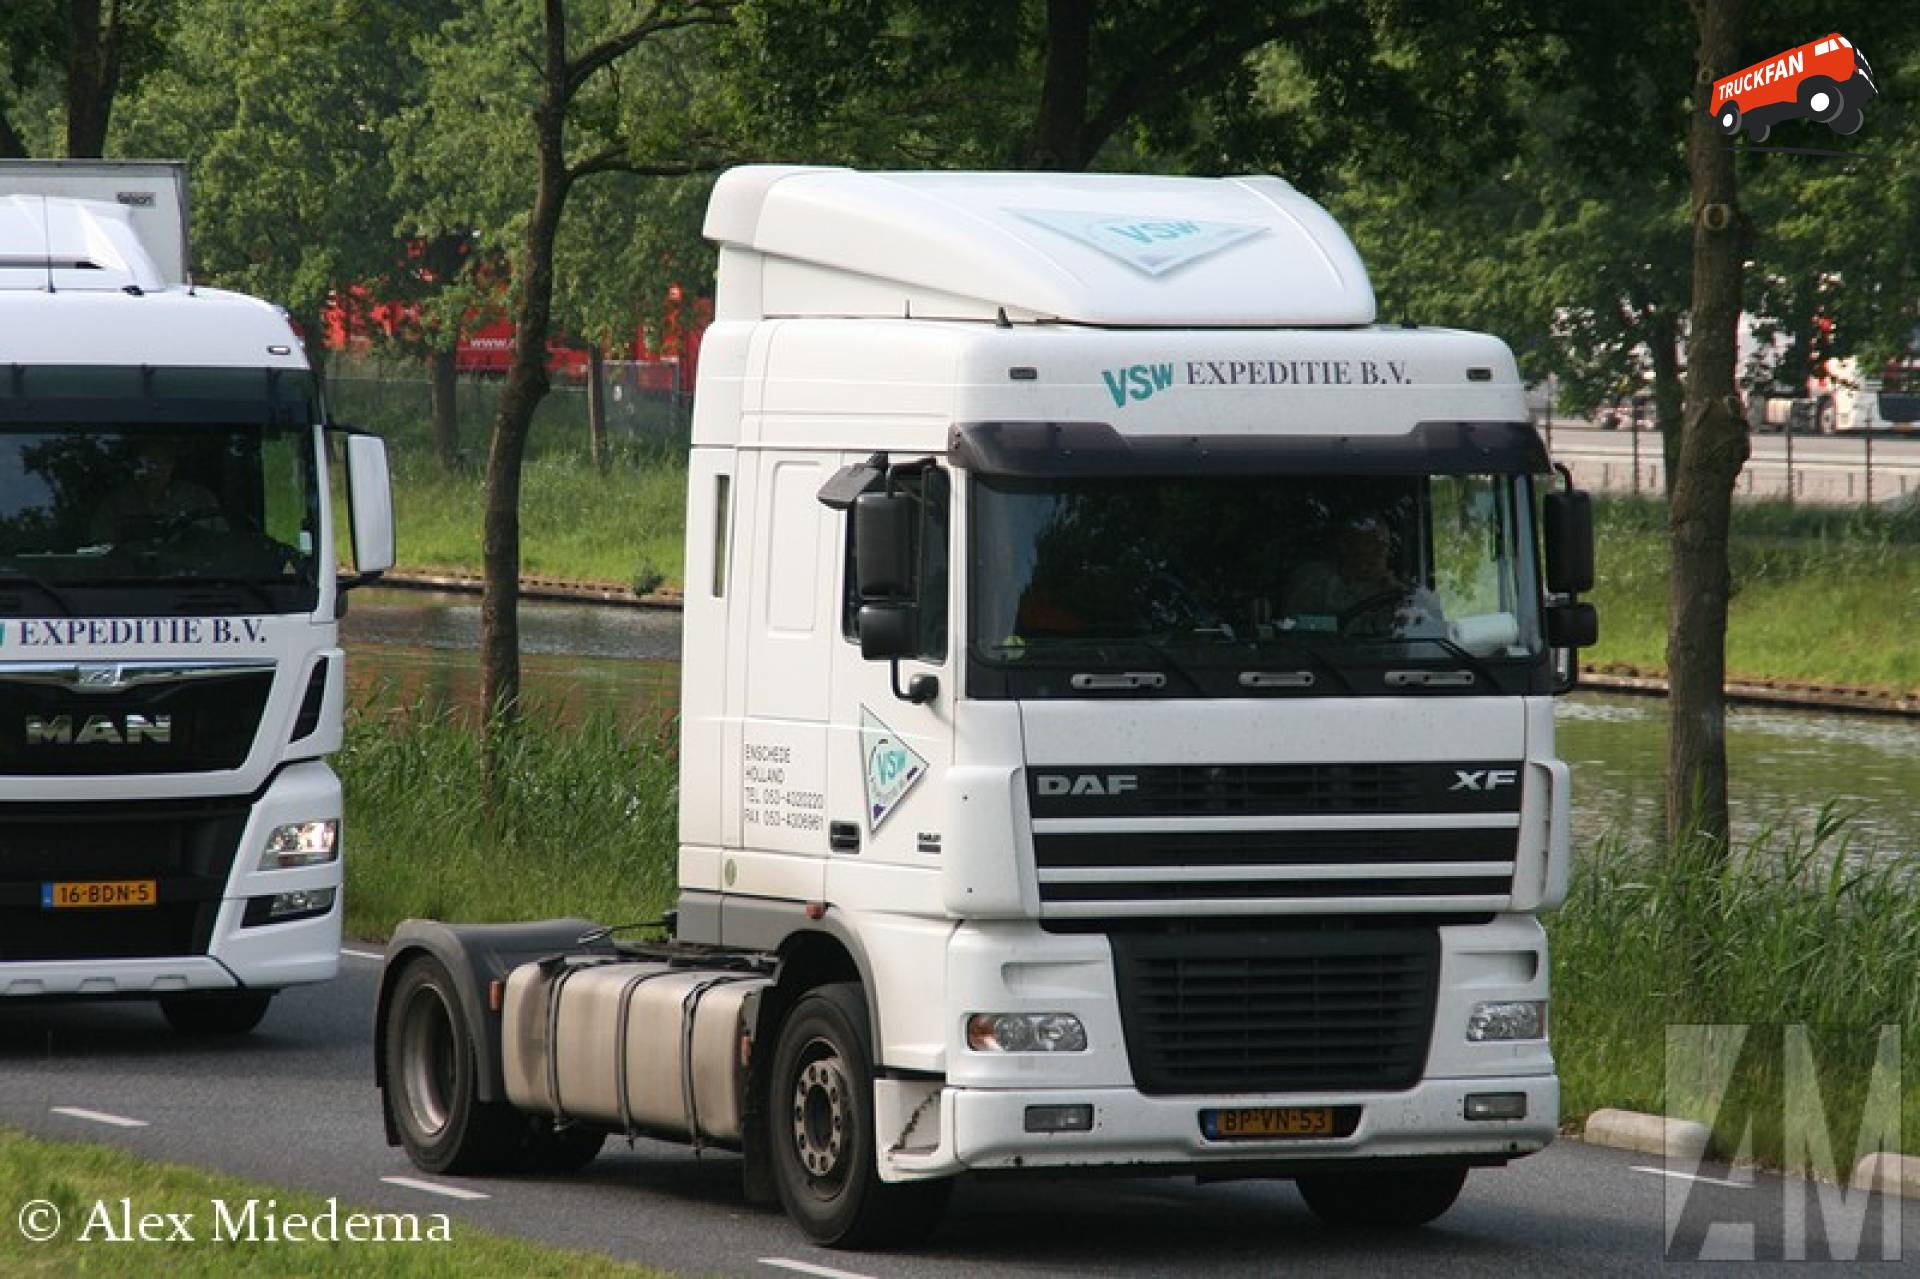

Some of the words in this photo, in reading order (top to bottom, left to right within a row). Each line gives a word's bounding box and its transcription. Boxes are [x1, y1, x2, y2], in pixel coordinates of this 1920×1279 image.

[1103, 220, 1200, 243] VSW
[1102, 362, 1174, 408] VSW
[1187, 361, 1350, 386] EXPEDITIE
[1361, 360, 1413, 386] B.V.
[19, 619, 202, 646] EXPEDITIE
[212, 618, 267, 644] B.V.
[25, 714, 172, 744] MAN
[745, 743, 791, 764] ENSCHEDE
[745, 766, 786, 785] HOLLAND
[1037, 774, 1139, 796] DAF
[1448, 769, 1518, 791] XF
[60, 884, 150, 904] 16-BDN-5
[1225, 1109, 1326, 1133] BP-VN-53
